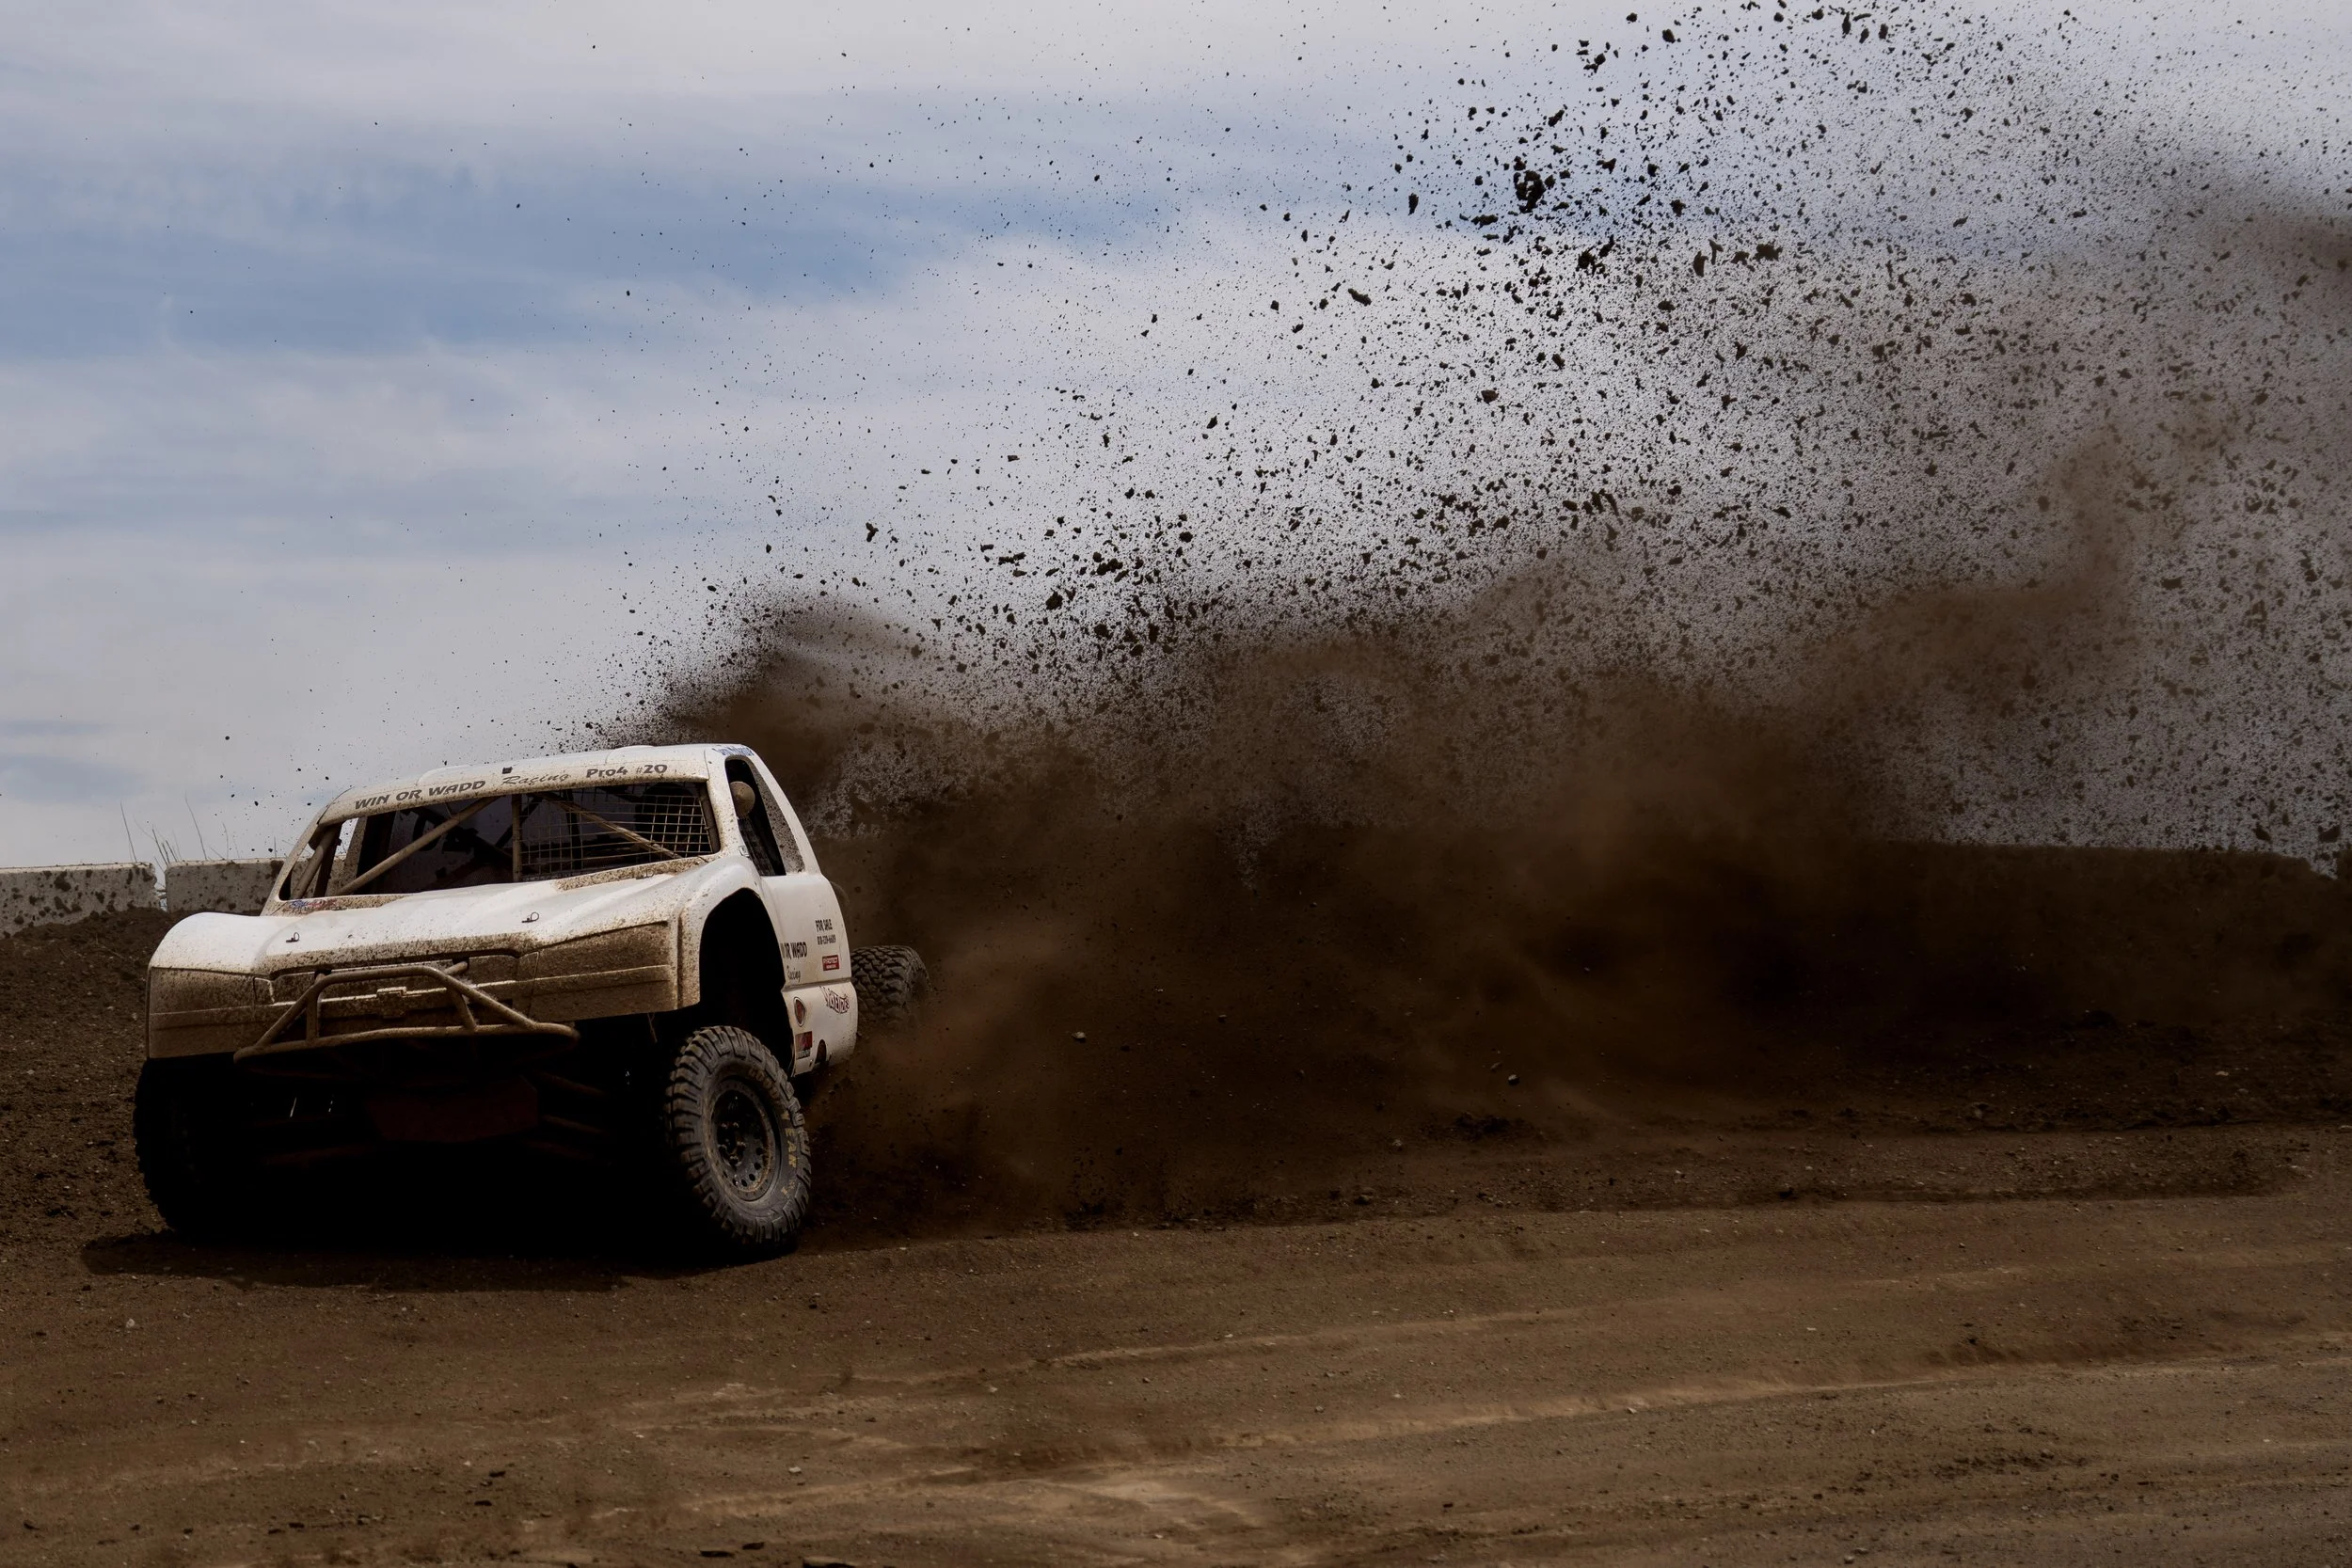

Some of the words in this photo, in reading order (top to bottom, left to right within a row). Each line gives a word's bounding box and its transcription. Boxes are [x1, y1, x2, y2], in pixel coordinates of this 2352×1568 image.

[355, 794, 389, 810] WIN
[396, 789, 422, 800] OR
[428, 780, 486, 797] WADD
[501, 774, 571, 786] Racing
[586, 766, 628, 779] Pro4
[635, 764, 668, 774] #20
[815, 919, 824, 932] FOR
[823, 918, 833, 931] SALE
[790, 942, 807, 958] WADD
